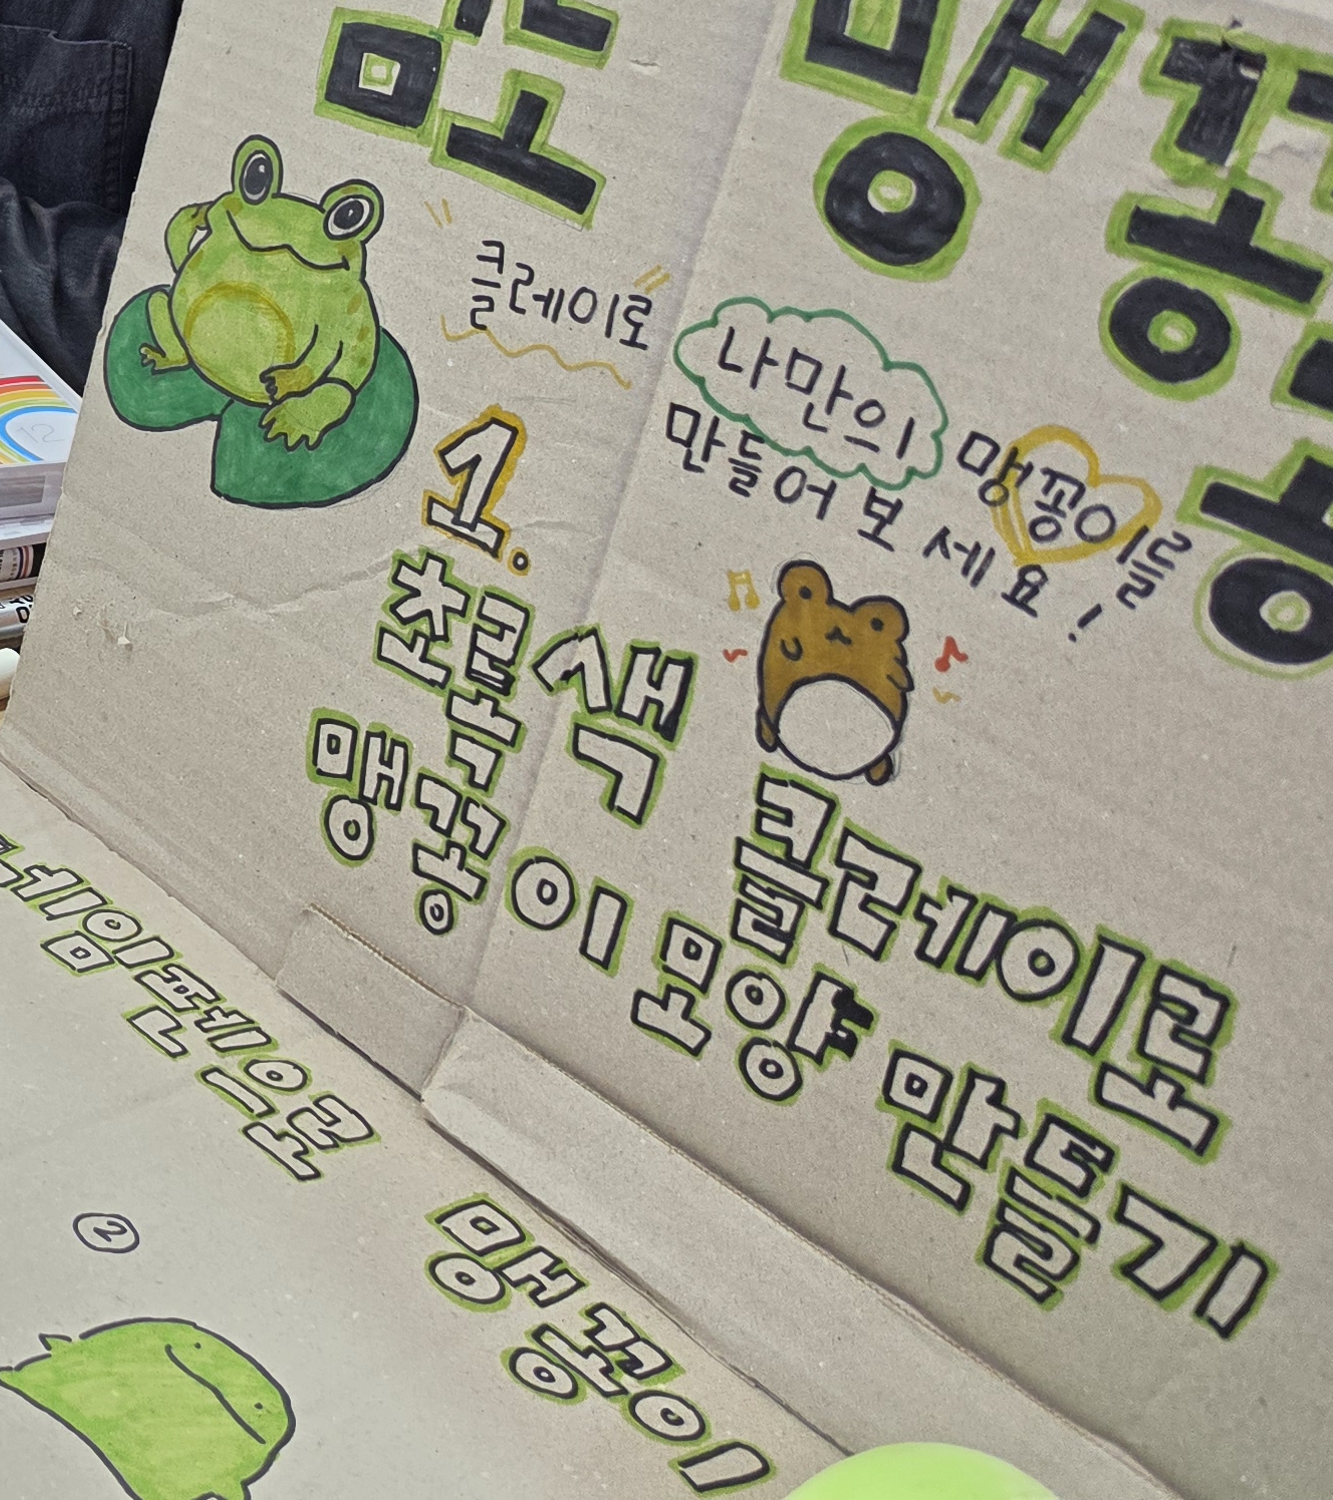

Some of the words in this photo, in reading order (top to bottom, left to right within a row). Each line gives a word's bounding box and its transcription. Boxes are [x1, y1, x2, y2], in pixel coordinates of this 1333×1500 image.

[469, 237, 655, 352] 클레이로
[664, 400, 836, 525] 만들어
[717, 325, 916, 463] 나만의
[953, 429, 1193, 614] 맹꽁이를
[376, 548, 699, 826] 초록색
[309, 708, 629, 974] 맹꽁이
[630, 914, 876, 1102] 모양
[880, 1044, 1271, 1340] 만들기
[733, 768, 1238, 1160] 클레이로
[428, 1195, 776, 1494] 맹꽁이
